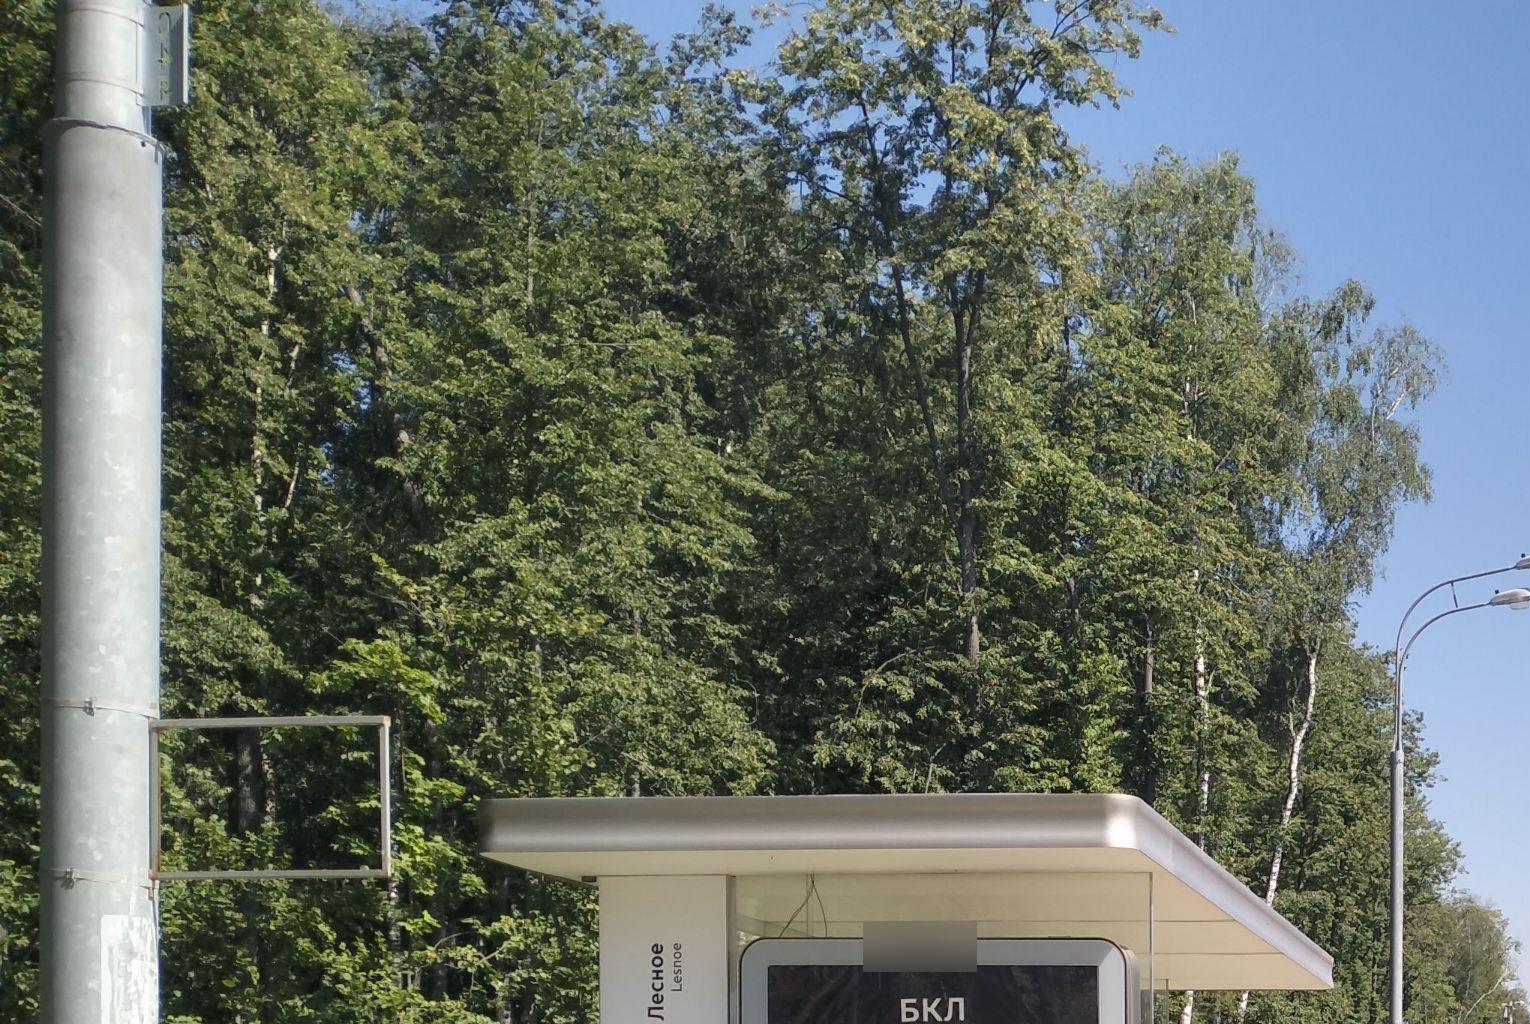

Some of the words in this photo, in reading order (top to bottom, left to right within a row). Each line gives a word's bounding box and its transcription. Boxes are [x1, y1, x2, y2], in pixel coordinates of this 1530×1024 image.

[647, 942, 664, 1021] Лесное
[670, 942, 682, 992] Lesnoe
[900, 997, 965, 1023] БКЛ
